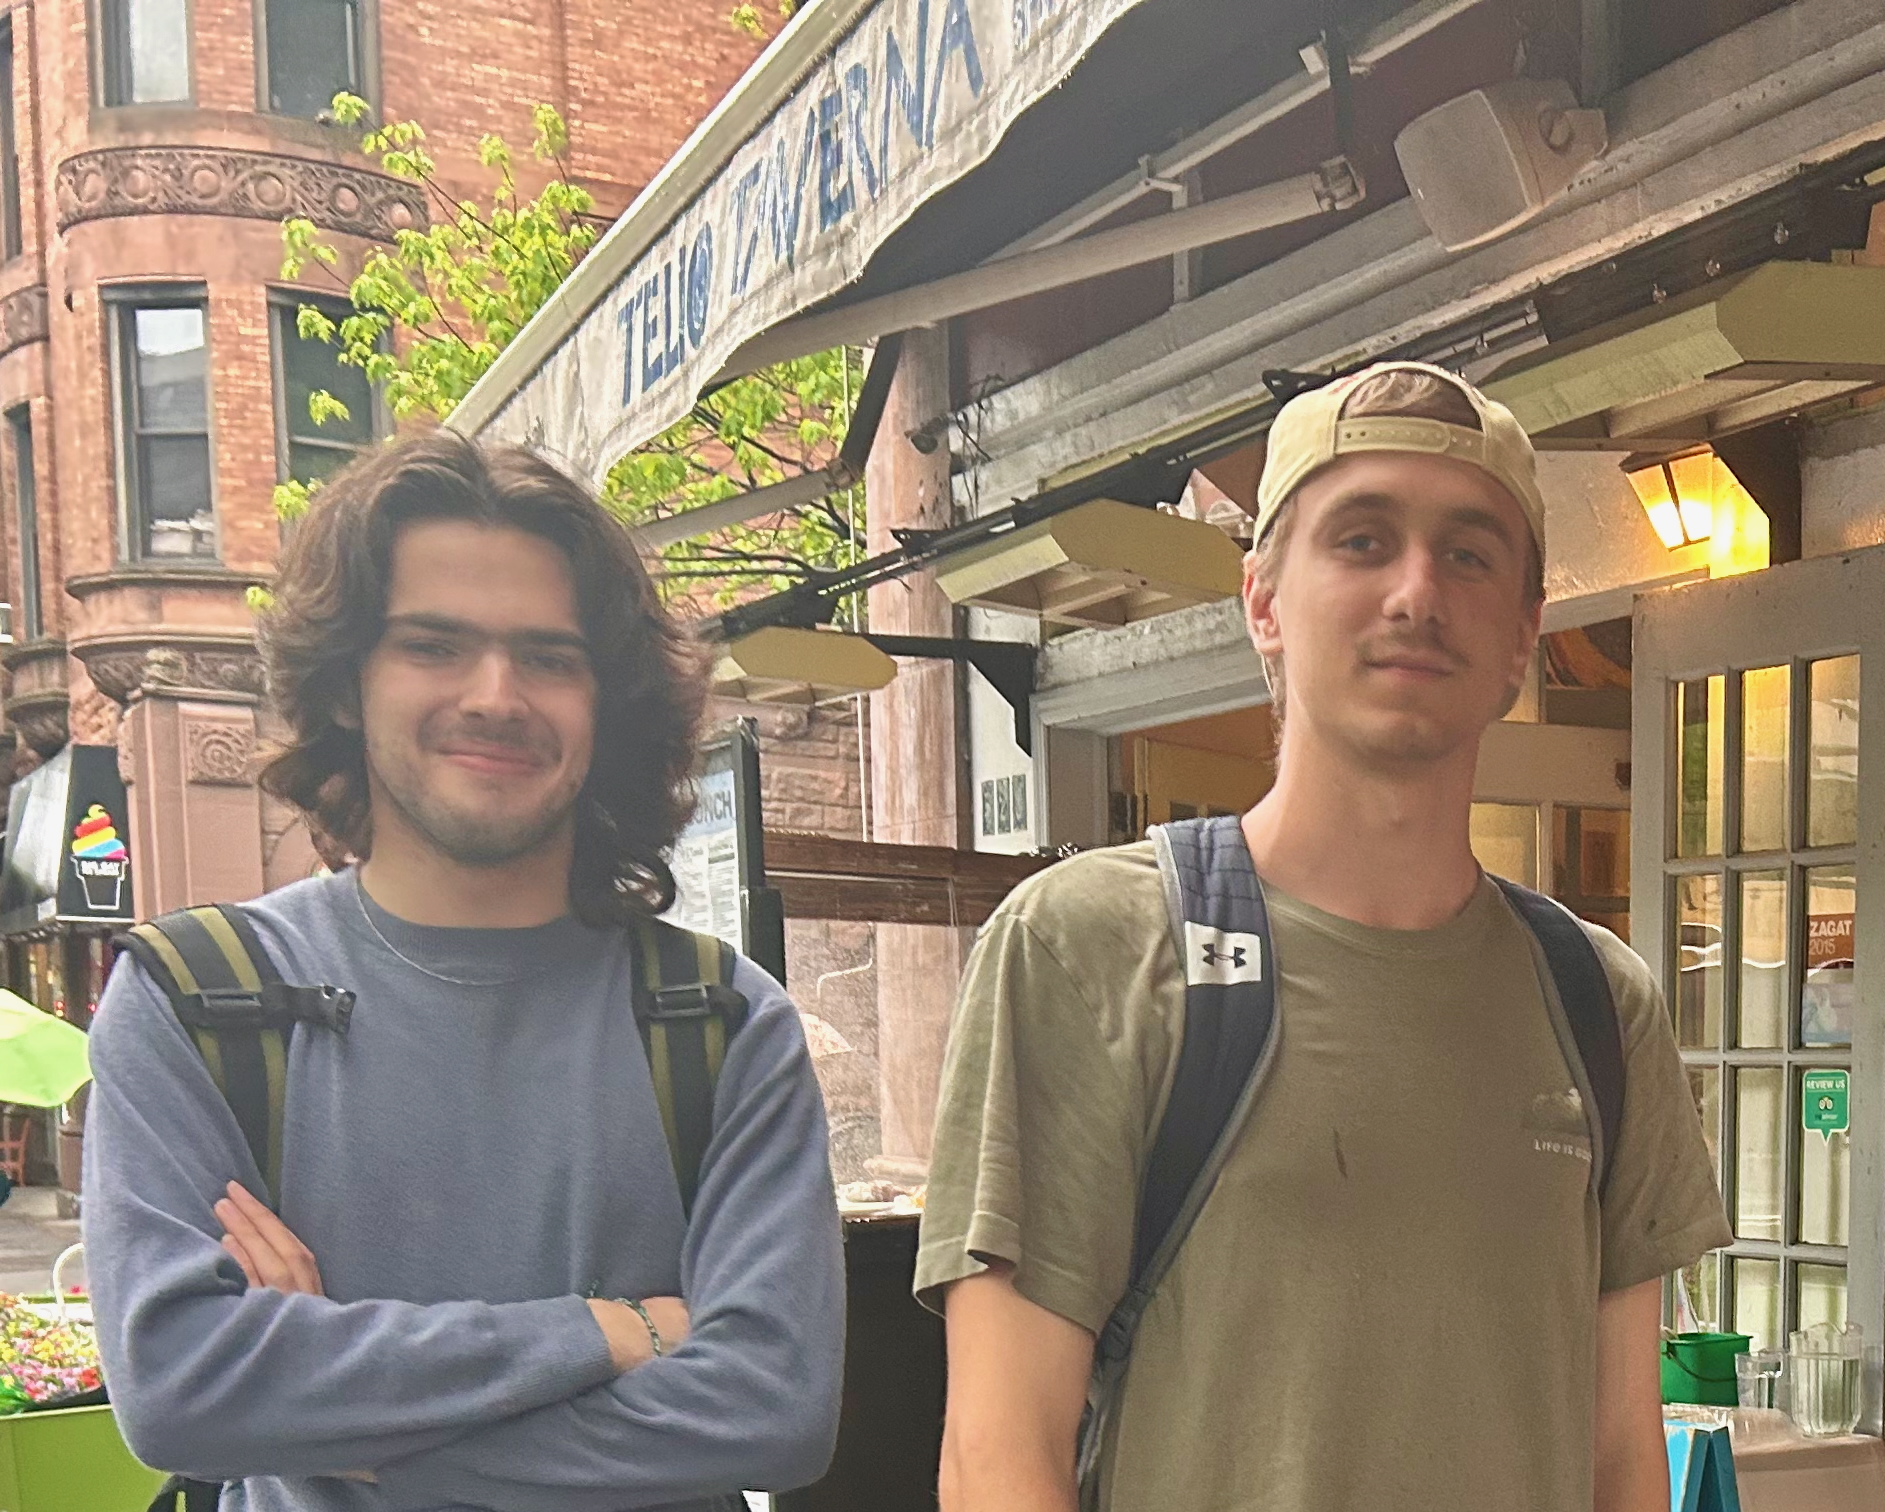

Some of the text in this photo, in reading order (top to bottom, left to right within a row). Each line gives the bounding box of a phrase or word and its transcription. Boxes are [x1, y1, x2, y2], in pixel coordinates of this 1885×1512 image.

[731, 0, 984, 297] TAVERNA
[689, 790, 733, 825] UNCH
[1809, 920, 1853, 937] ZAGAT
[1809, 938, 1836, 955] 2015
[1806, 1080, 1846, 1089] REVIEW US
